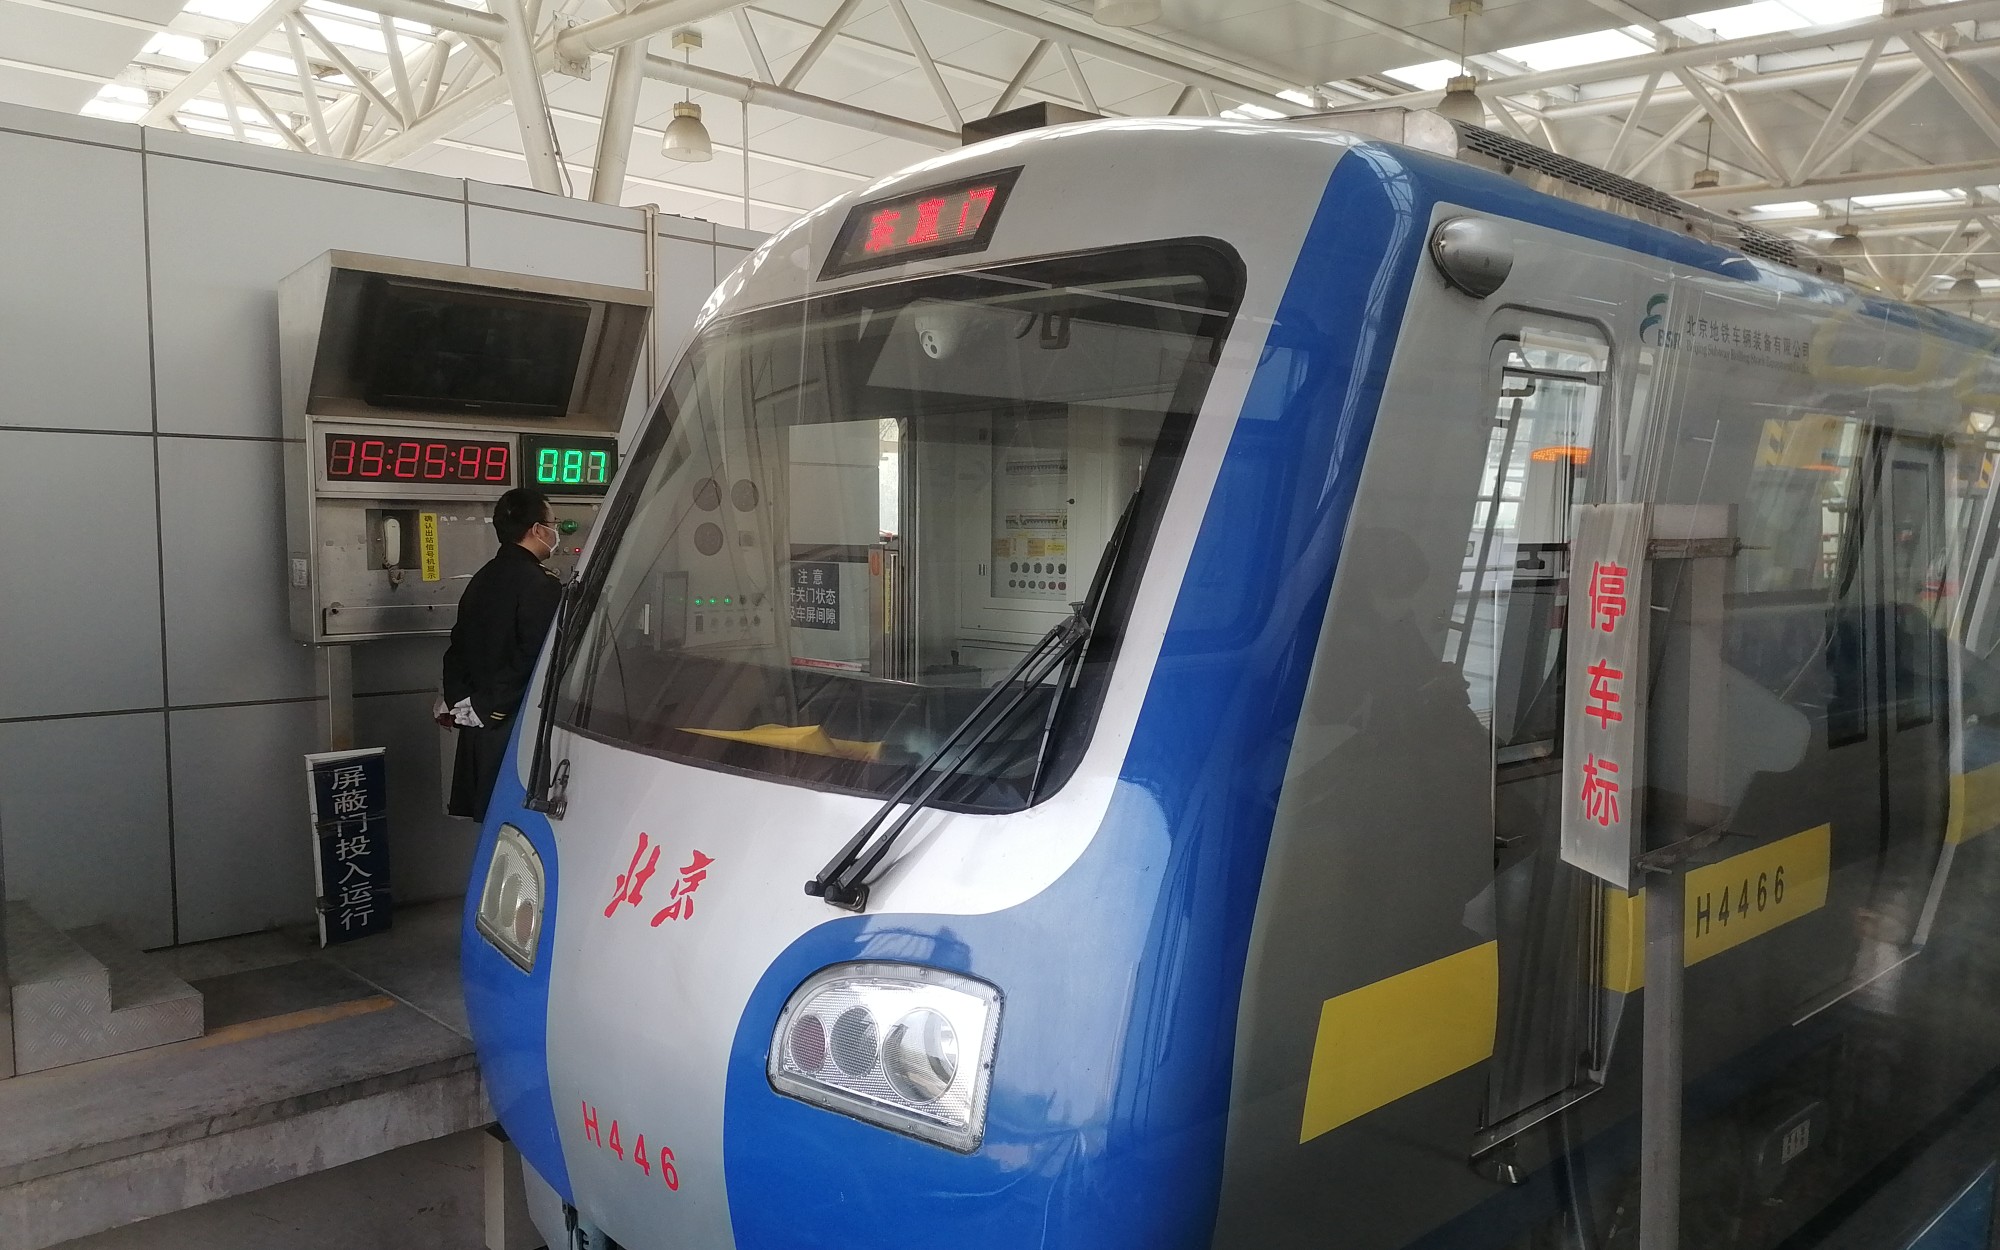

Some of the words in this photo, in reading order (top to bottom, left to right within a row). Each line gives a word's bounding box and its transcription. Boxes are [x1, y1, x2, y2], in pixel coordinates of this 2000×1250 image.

[346, 440, 508, 481] 15:25:49
[538, 449, 607, 483] 087
[424, 515, 436, 579] 确认出站信号机显示
[1582, 560, 1629, 826] 停车标
[331, 765, 375, 931] 屏蔽门投入运行
[604, 832, 715, 928] 北京
[1696, 865, 1785, 938] H4466
[582, 1100, 679, 1191] H446
